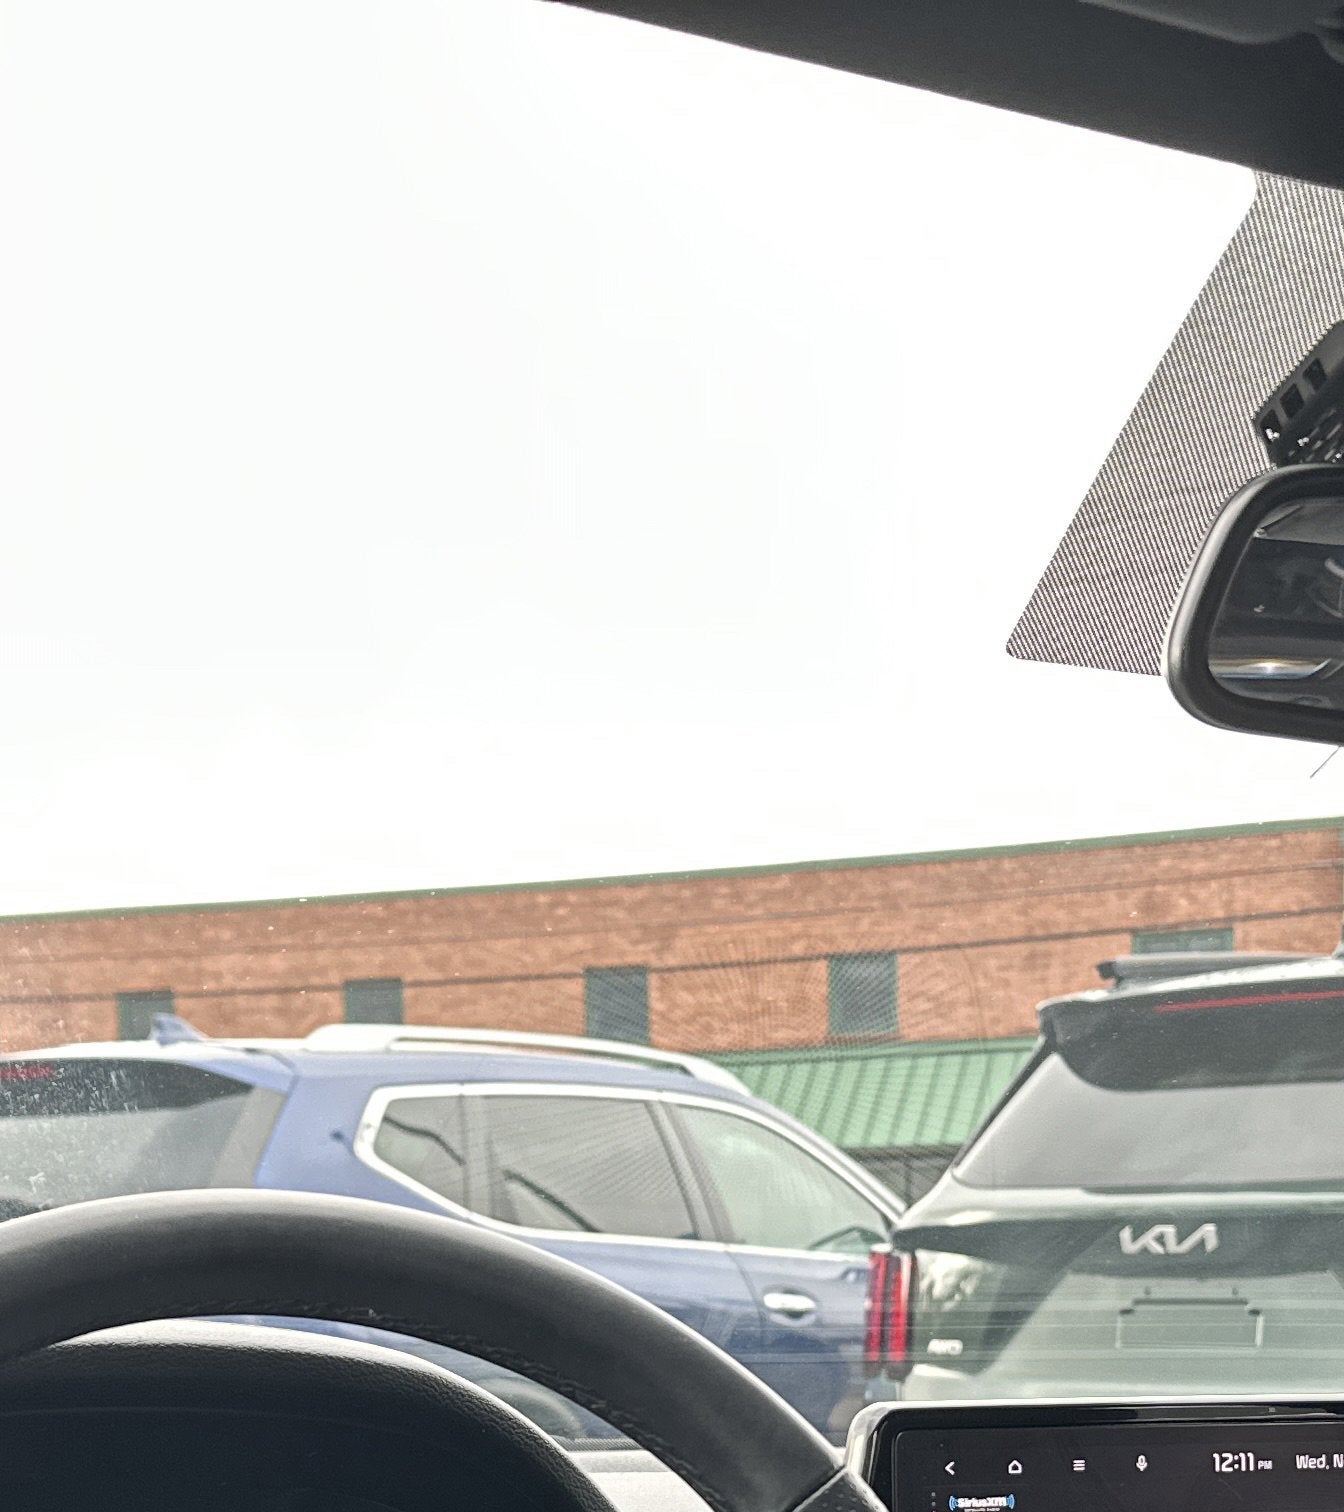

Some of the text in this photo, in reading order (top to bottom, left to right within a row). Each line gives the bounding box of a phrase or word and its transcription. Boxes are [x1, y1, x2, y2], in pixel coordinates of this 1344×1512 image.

[1118, 1222, 1219, 1254] KIA
[1213, 1452, 1273, 1473] 12:11 PM
